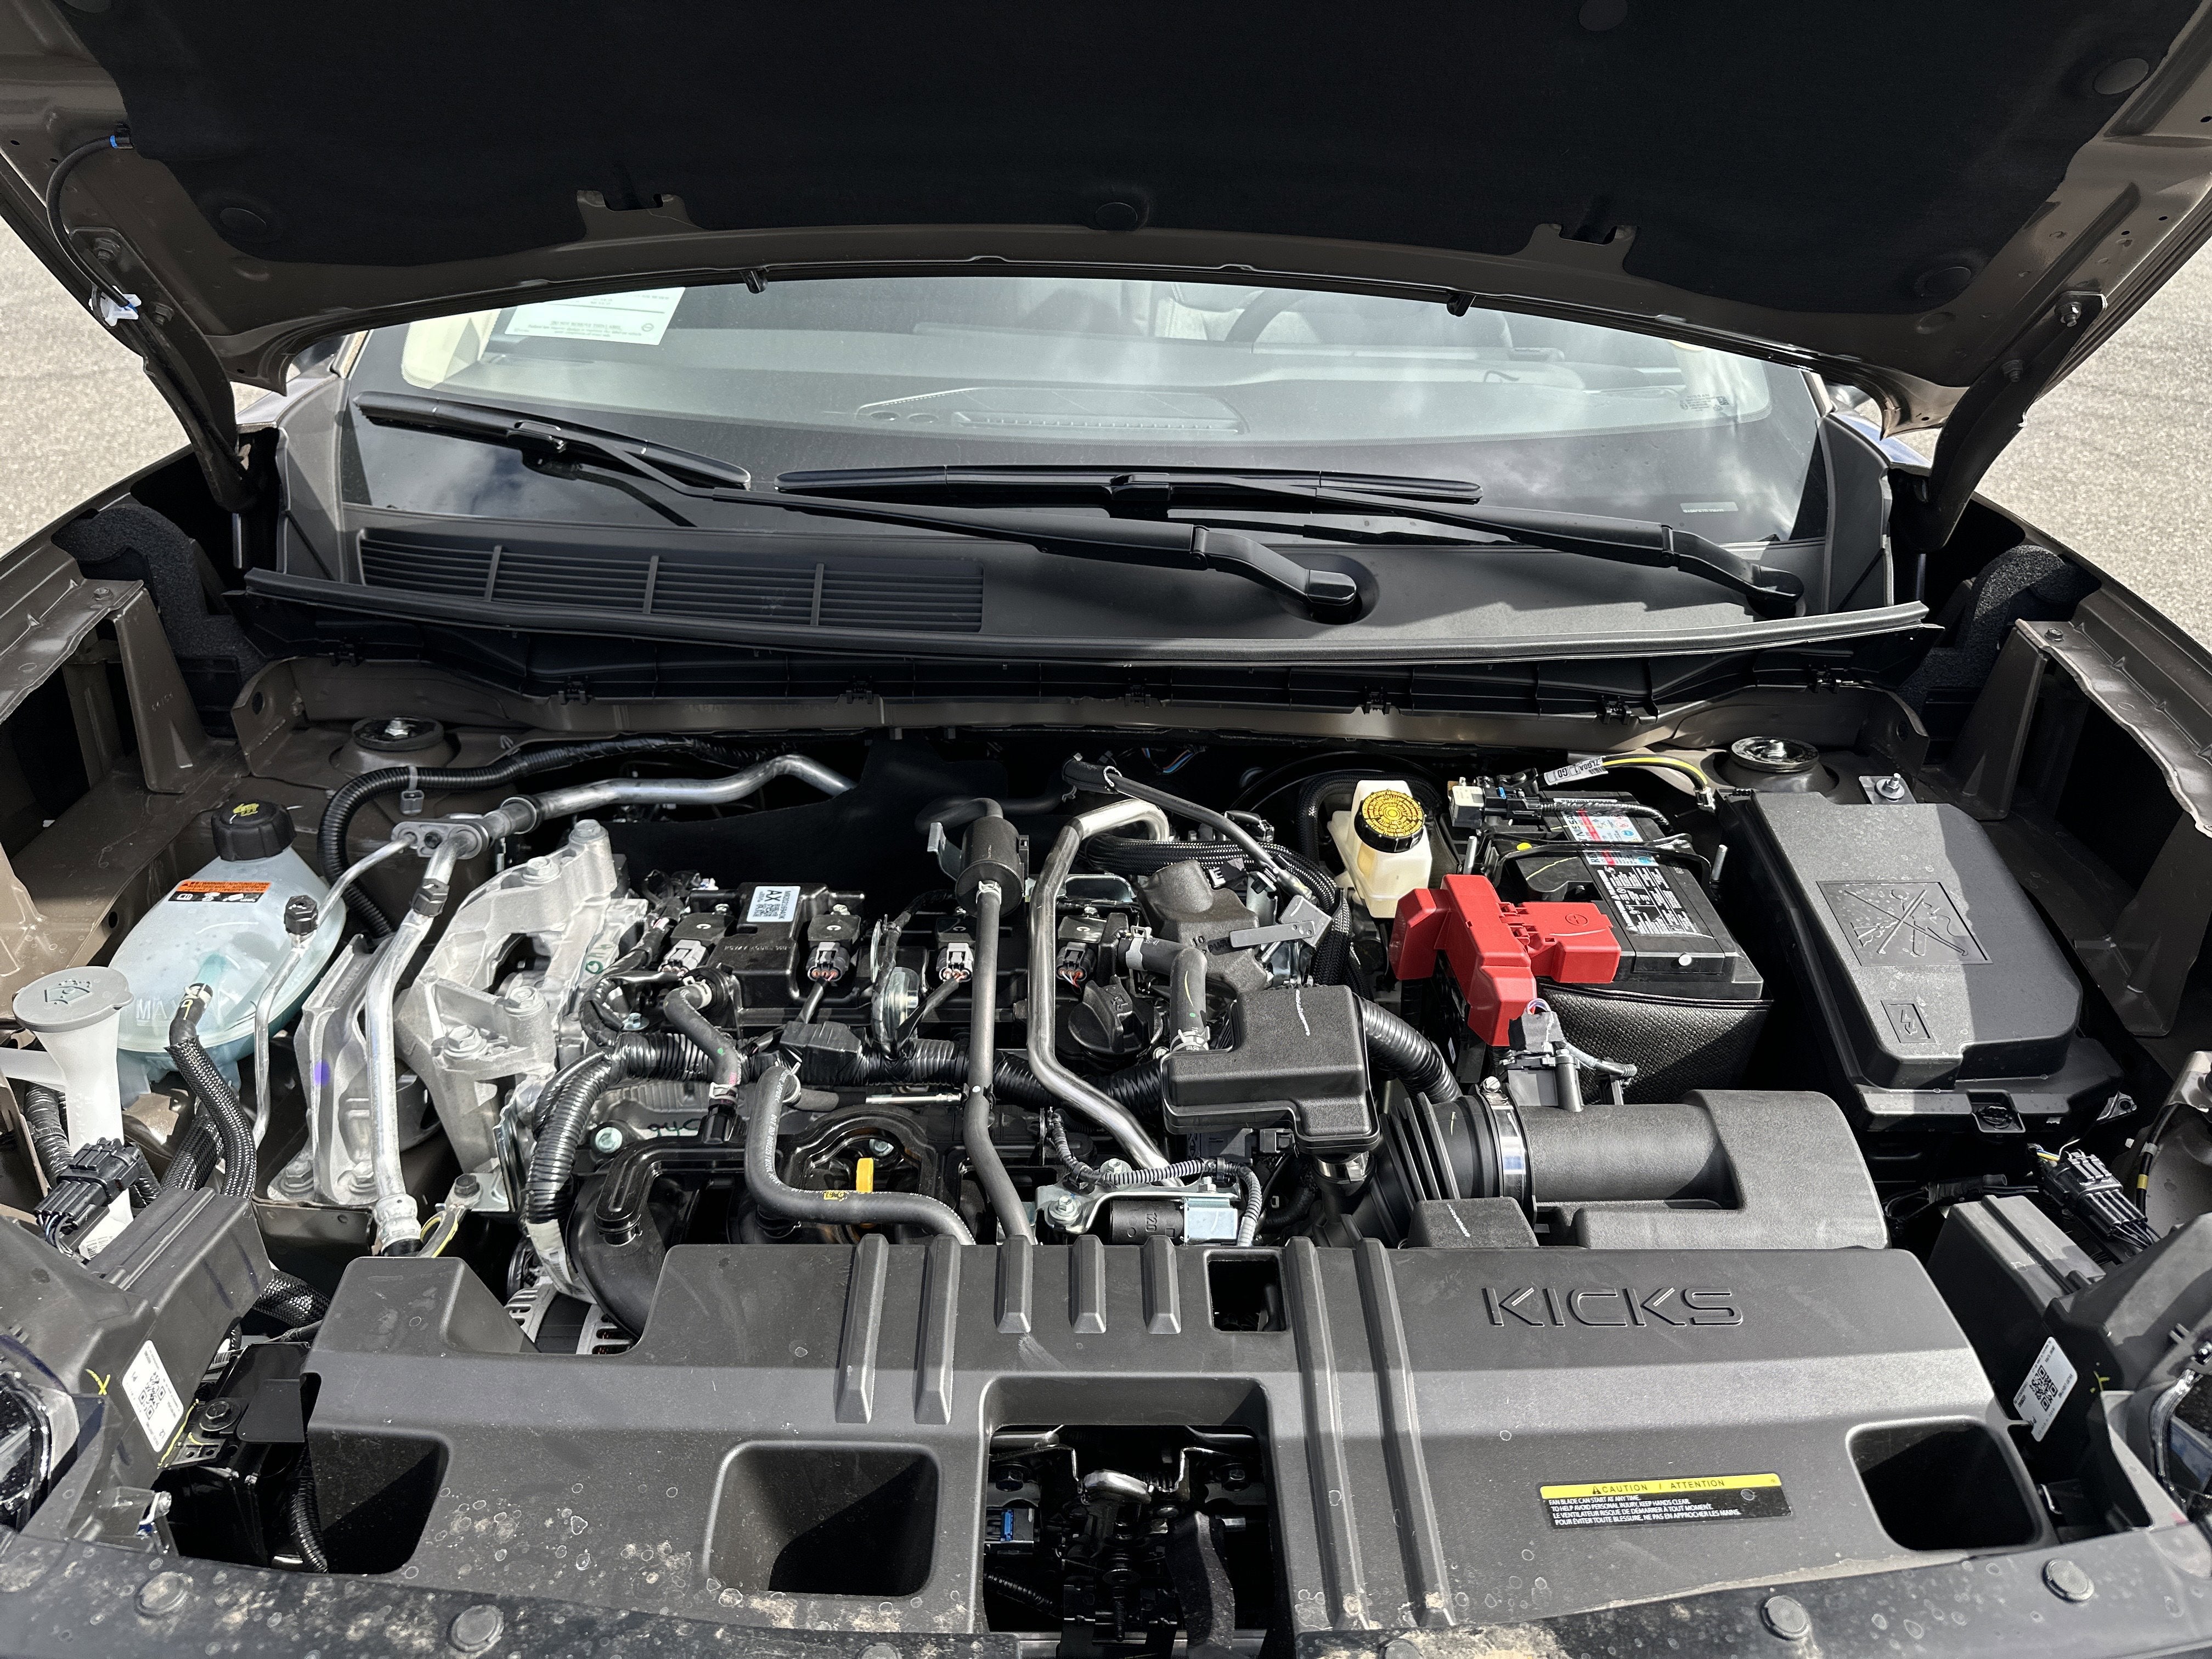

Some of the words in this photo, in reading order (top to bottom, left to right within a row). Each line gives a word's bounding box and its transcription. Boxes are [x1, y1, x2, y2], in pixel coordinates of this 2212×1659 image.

[765, 890, 782, 902] AX
[1146, 1212, 1157, 1232] 120
[1482, 1286, 1744, 1327] KICKS
[1602, 1484, 1647, 1493] CAUTION
[1671, 1480, 1725, 1489] ATTENTION
[1632, 1506, 1663, 1514] DÉMARRER
[1673, 1511, 1708, 1519] APPROCHER
